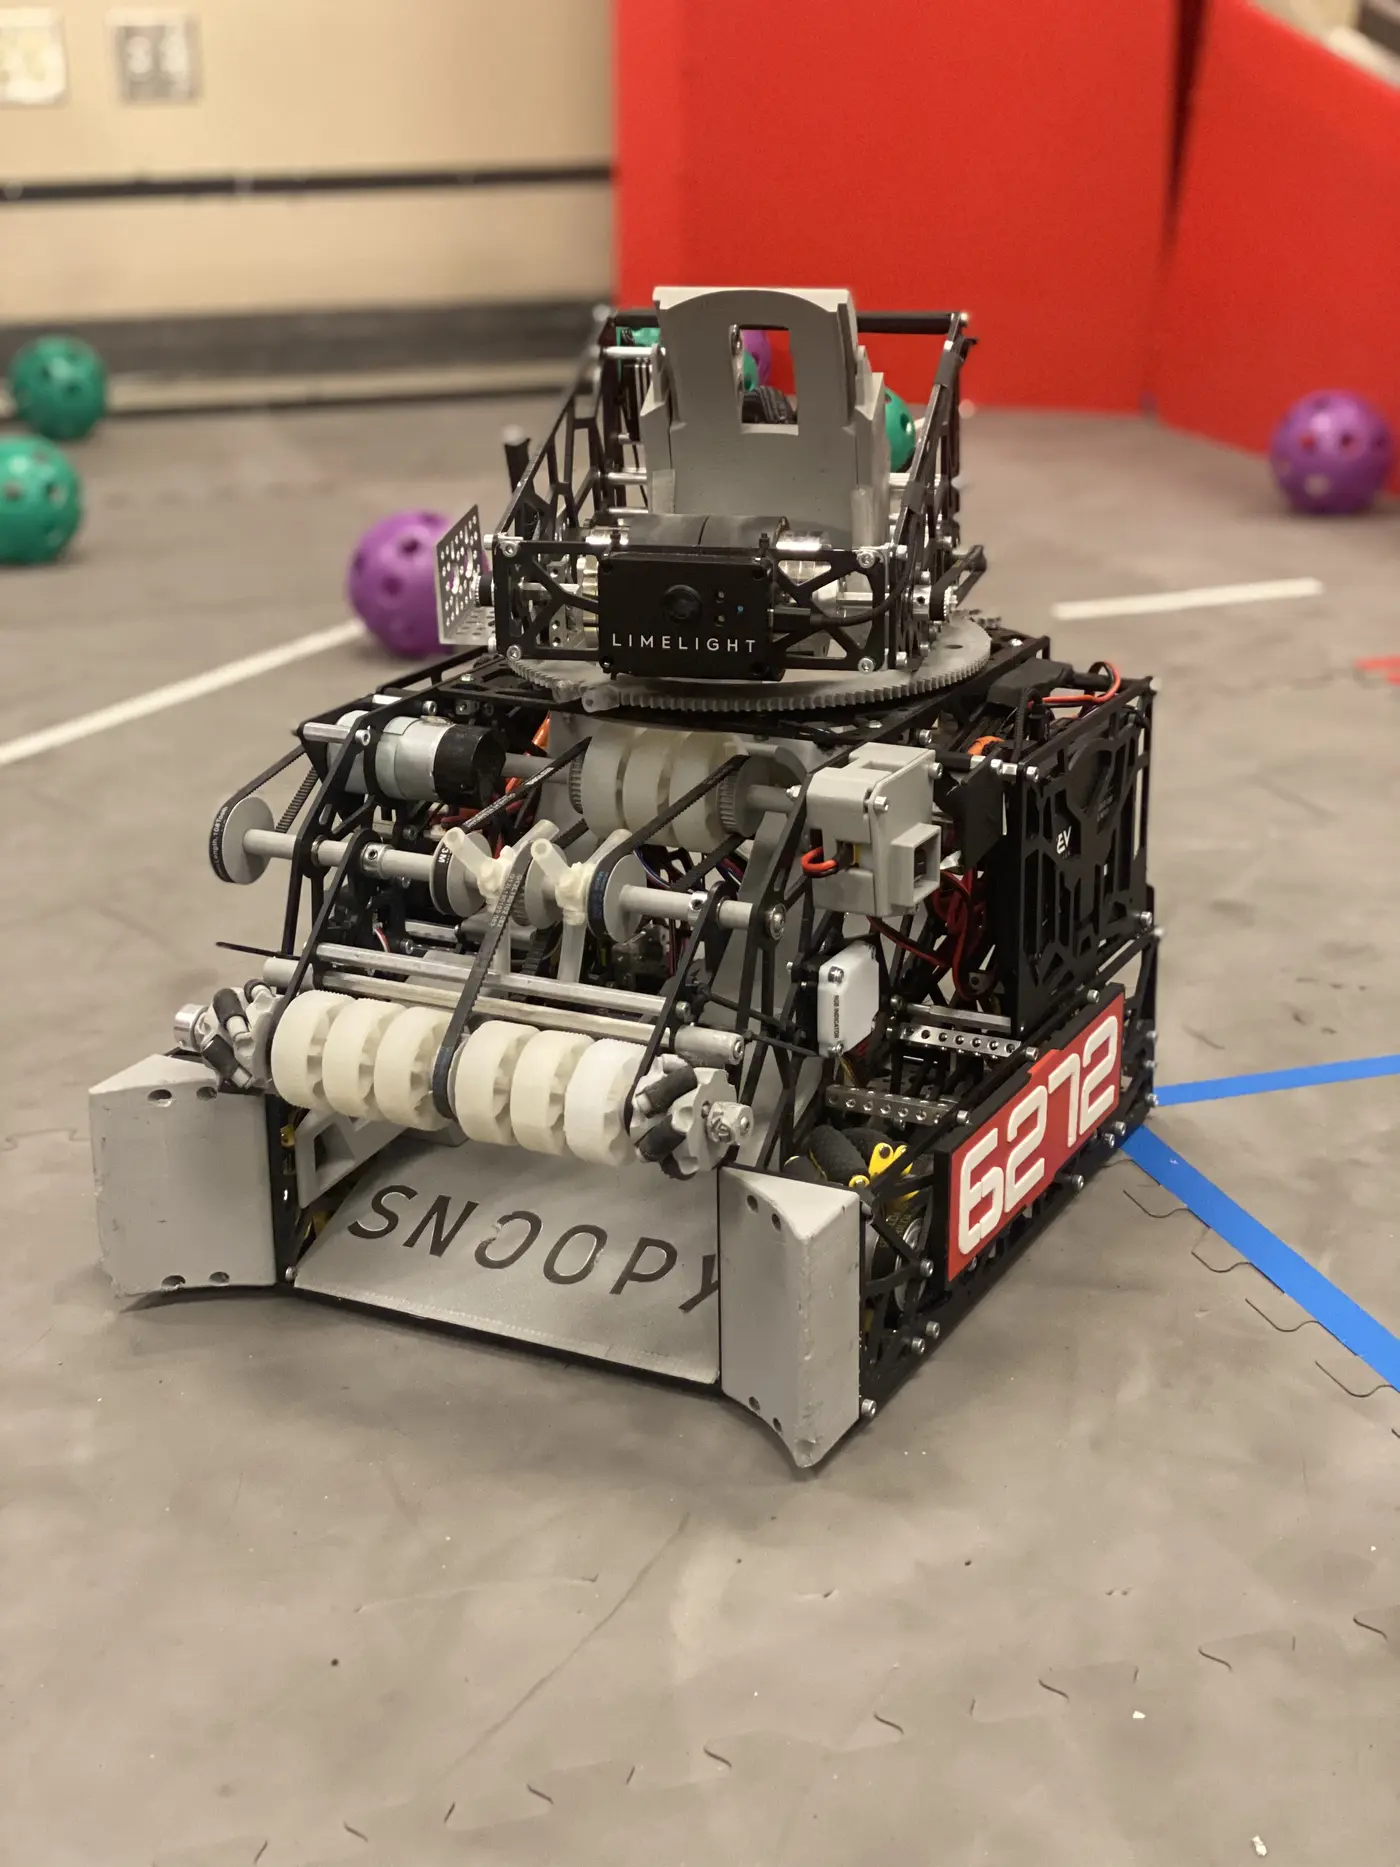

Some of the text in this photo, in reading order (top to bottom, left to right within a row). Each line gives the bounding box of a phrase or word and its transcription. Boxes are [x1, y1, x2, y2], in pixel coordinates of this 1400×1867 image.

[612, 633, 756, 653] LIMELIGHT
[958, 1015, 1118, 1255] 6272
[347, 1184, 719, 1314] SNOOPY
